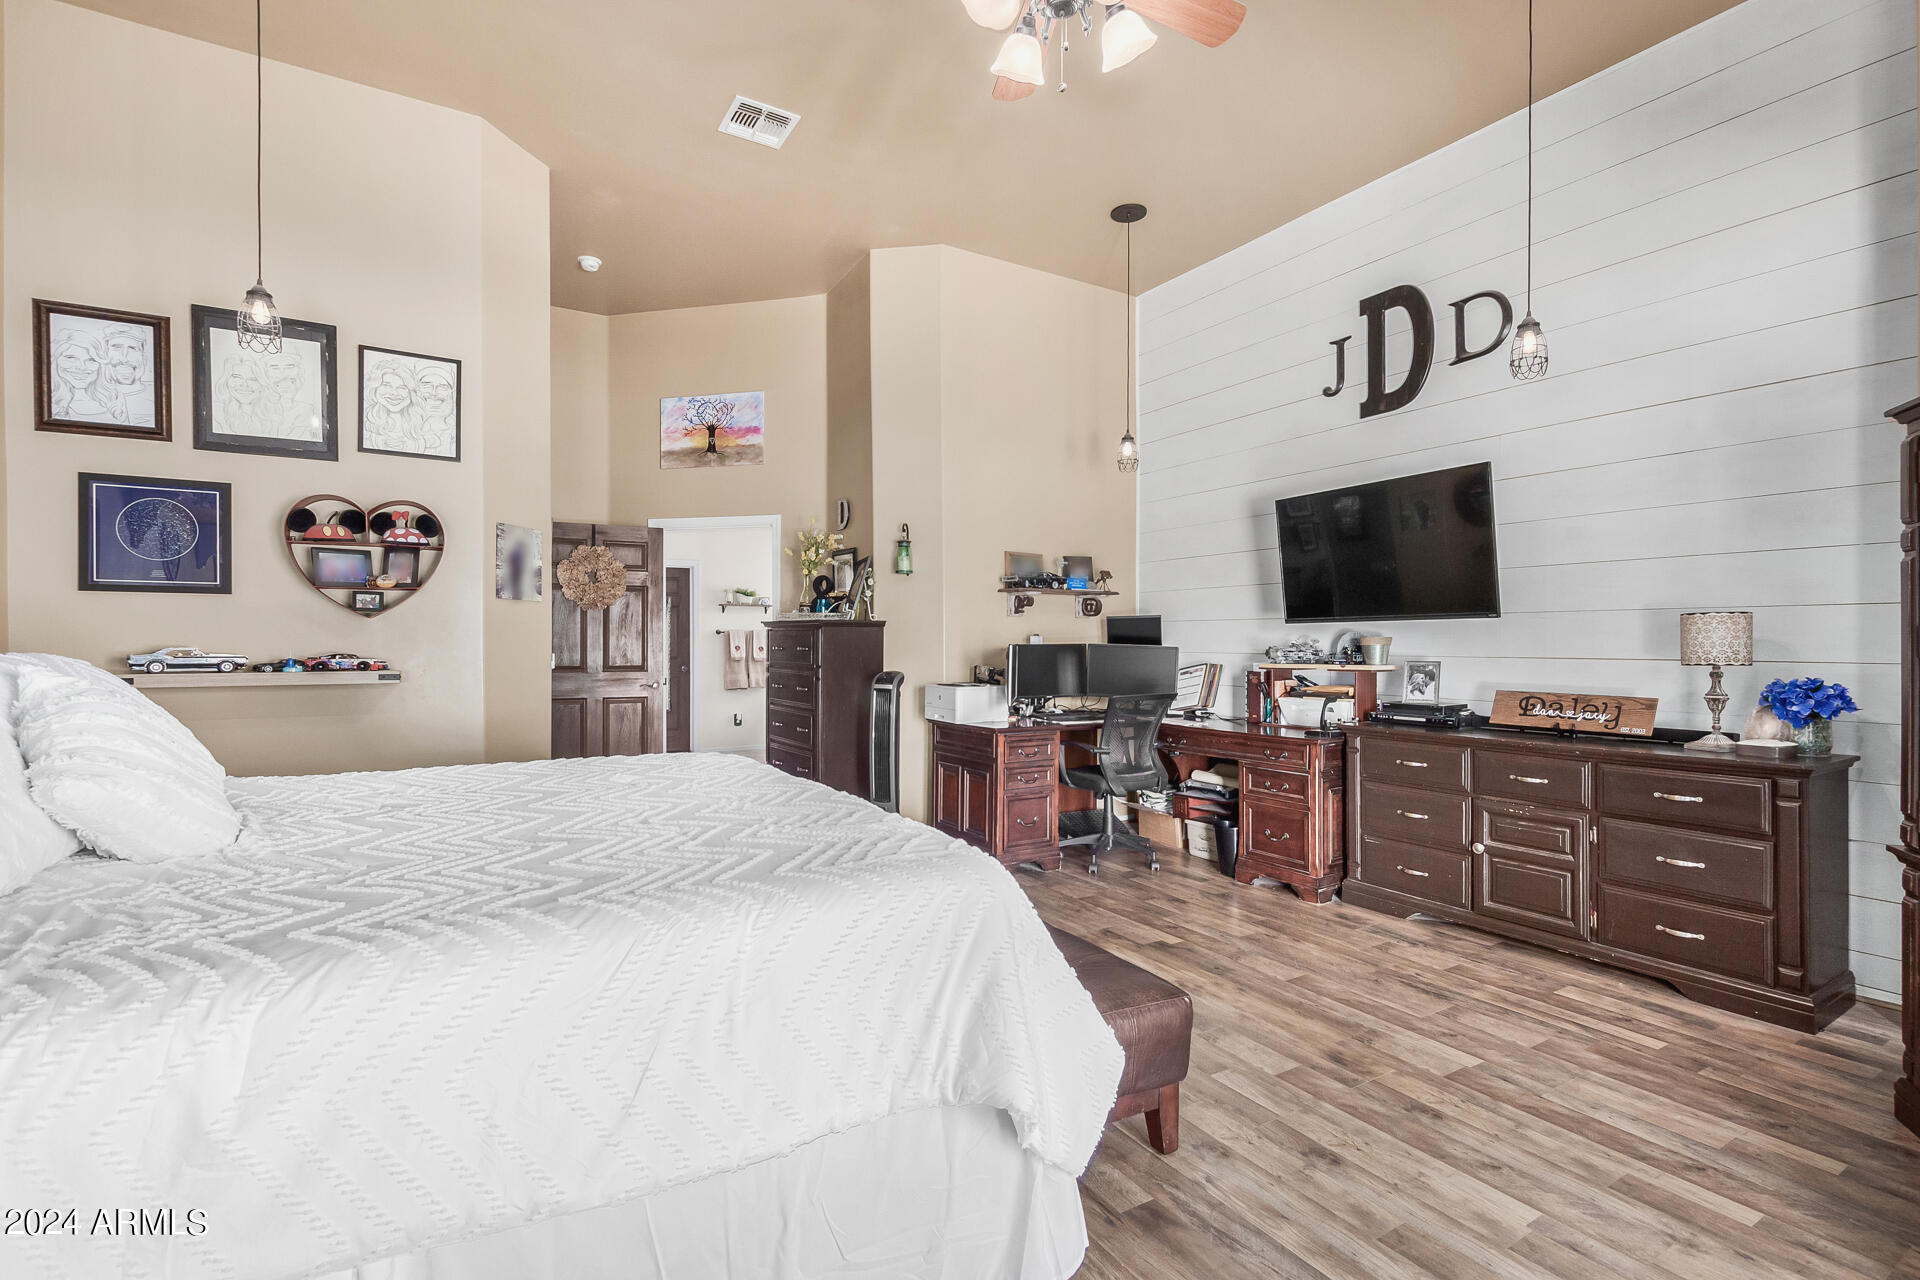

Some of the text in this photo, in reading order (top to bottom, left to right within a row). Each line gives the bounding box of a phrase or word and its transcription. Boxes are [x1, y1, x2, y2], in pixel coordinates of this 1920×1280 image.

[1323, 285, 1514, 419] J D D
[1519, 696, 1622, 730] Daley
